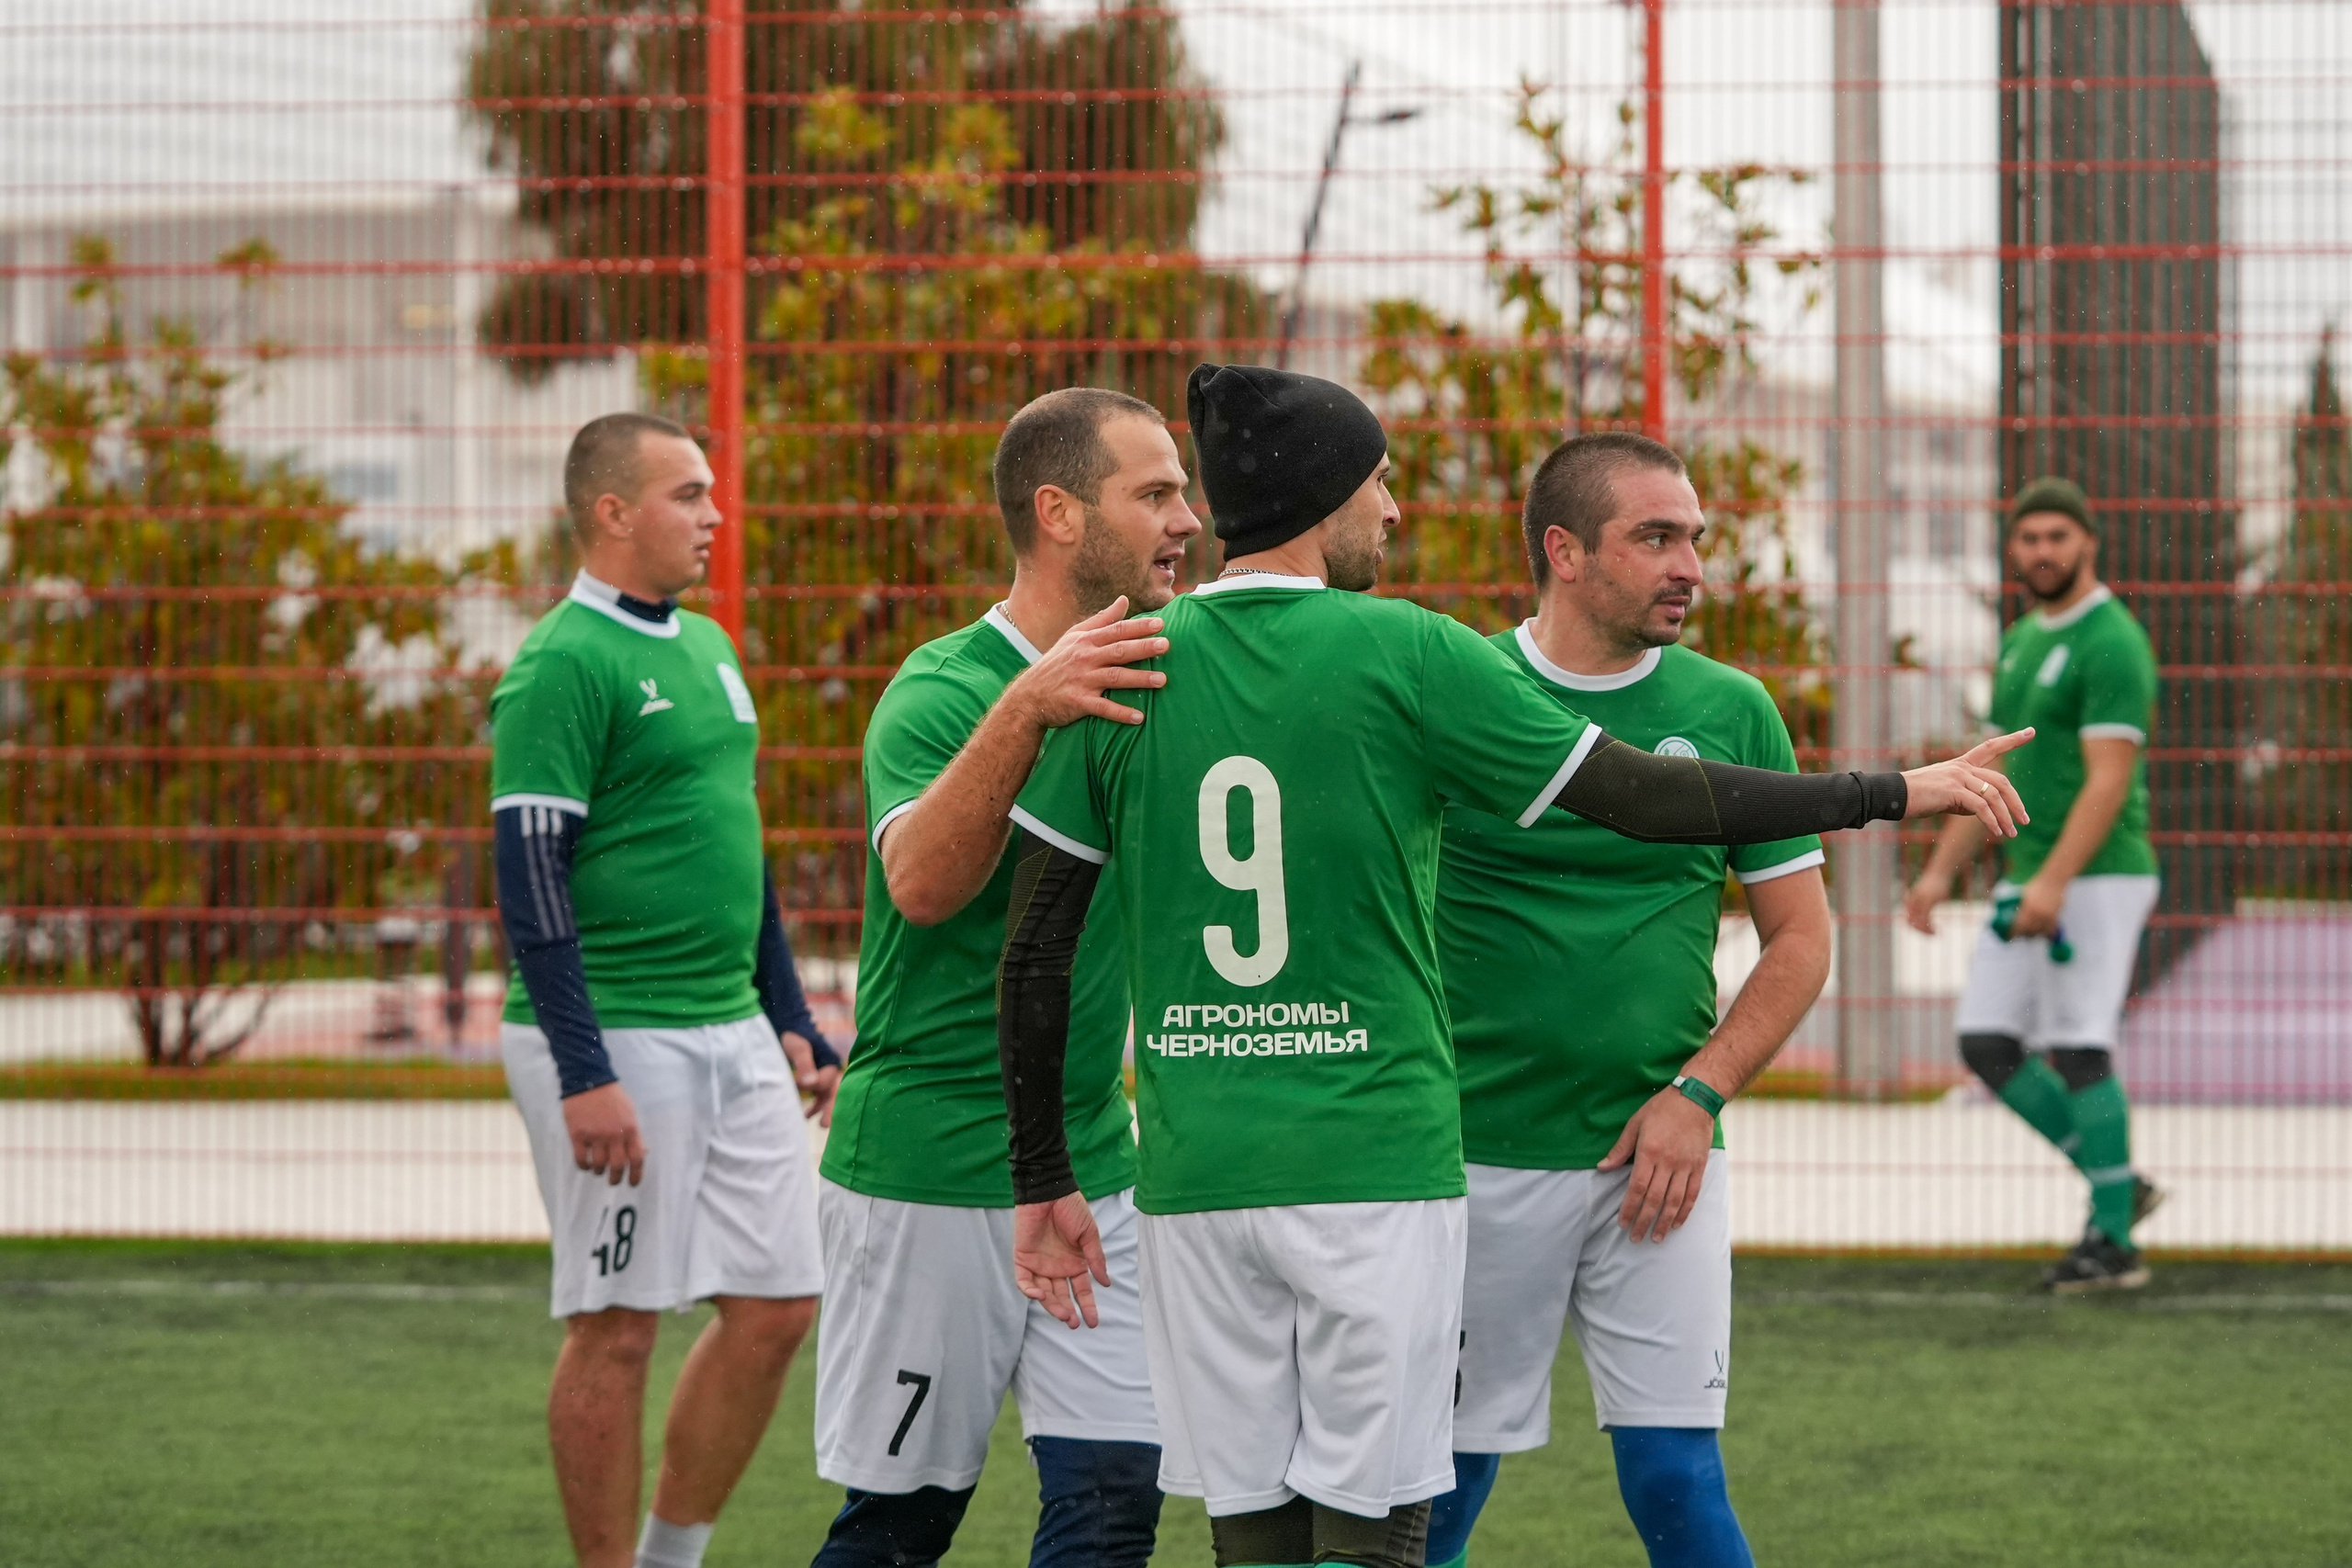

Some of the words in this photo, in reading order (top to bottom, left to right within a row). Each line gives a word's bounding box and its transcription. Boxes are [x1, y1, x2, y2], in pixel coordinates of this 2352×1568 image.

[1198, 755, 1289, 987] 9
[1147, 1029, 1368, 1057] ЧЕРНОЗЕМЬЯ
[1162, 1001, 1350, 1028] АГРОНОМЫ
[888, 1369, 932, 1457] 7
